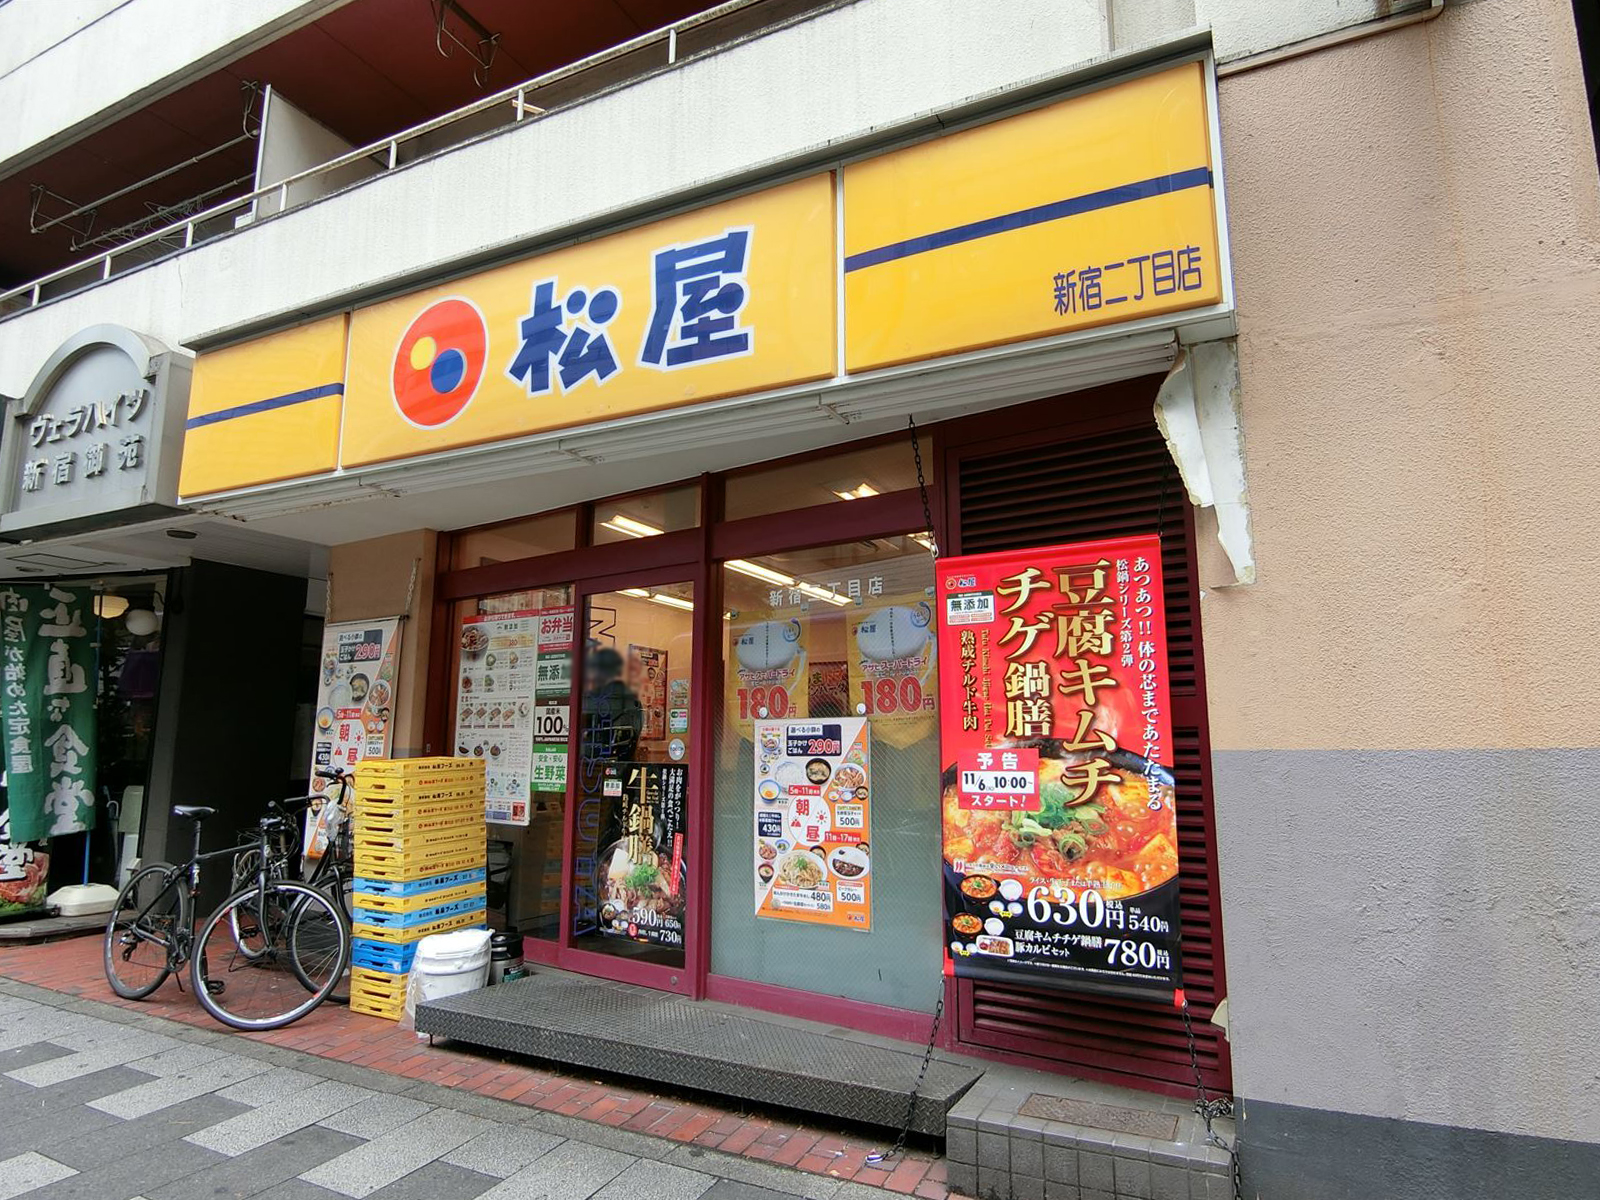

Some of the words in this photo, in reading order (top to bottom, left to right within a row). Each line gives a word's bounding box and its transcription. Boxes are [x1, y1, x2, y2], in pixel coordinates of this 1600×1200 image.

[1053, 245, 1201, 316] 新宿二丁目店
[506, 229, 751, 394] 松屋
[30, 389, 148, 448] ヴェラハイツ
[22, 433, 144, 492] 新宿御苑
[769, 576, 883, 607] 新宿二丁目店
[951, 597, 989, 612] 無添加
[1115, 559, 1134, 668] 松鍋シリーズ第2弾
[541, 616, 573, 634] お弁当
[996, 567, 1055, 738] チゲ鍋膳
[861, 657, 929, 671] アサヒスーパードライ
[959, 630, 979, 731] 熟成チルド牛肉
[1052, 558, 1123, 807] 豆腐キムチ
[860, 674, 935, 716] 180円
[339, 723, 350, 742] 朝
[808, 739, 841, 755] 290円
[976, 752, 1019, 770] 予告
[534, 765, 565, 781] 生野菜
[796, 799, 810, 816] 朝
[971, 795, 1027, 808] スタート!
[806, 826, 820, 842] 昼
[1027, 886, 1125, 930] 630円
[1105, 900, 1123, 909] 税込
[632, 907, 663, 928] 590円
[1129, 914, 1169, 933] 540円
[659, 929, 683, 944] 730円
[1014, 942, 1070, 957] 豚カルビセット
[1104, 938, 1171, 970] 780円
